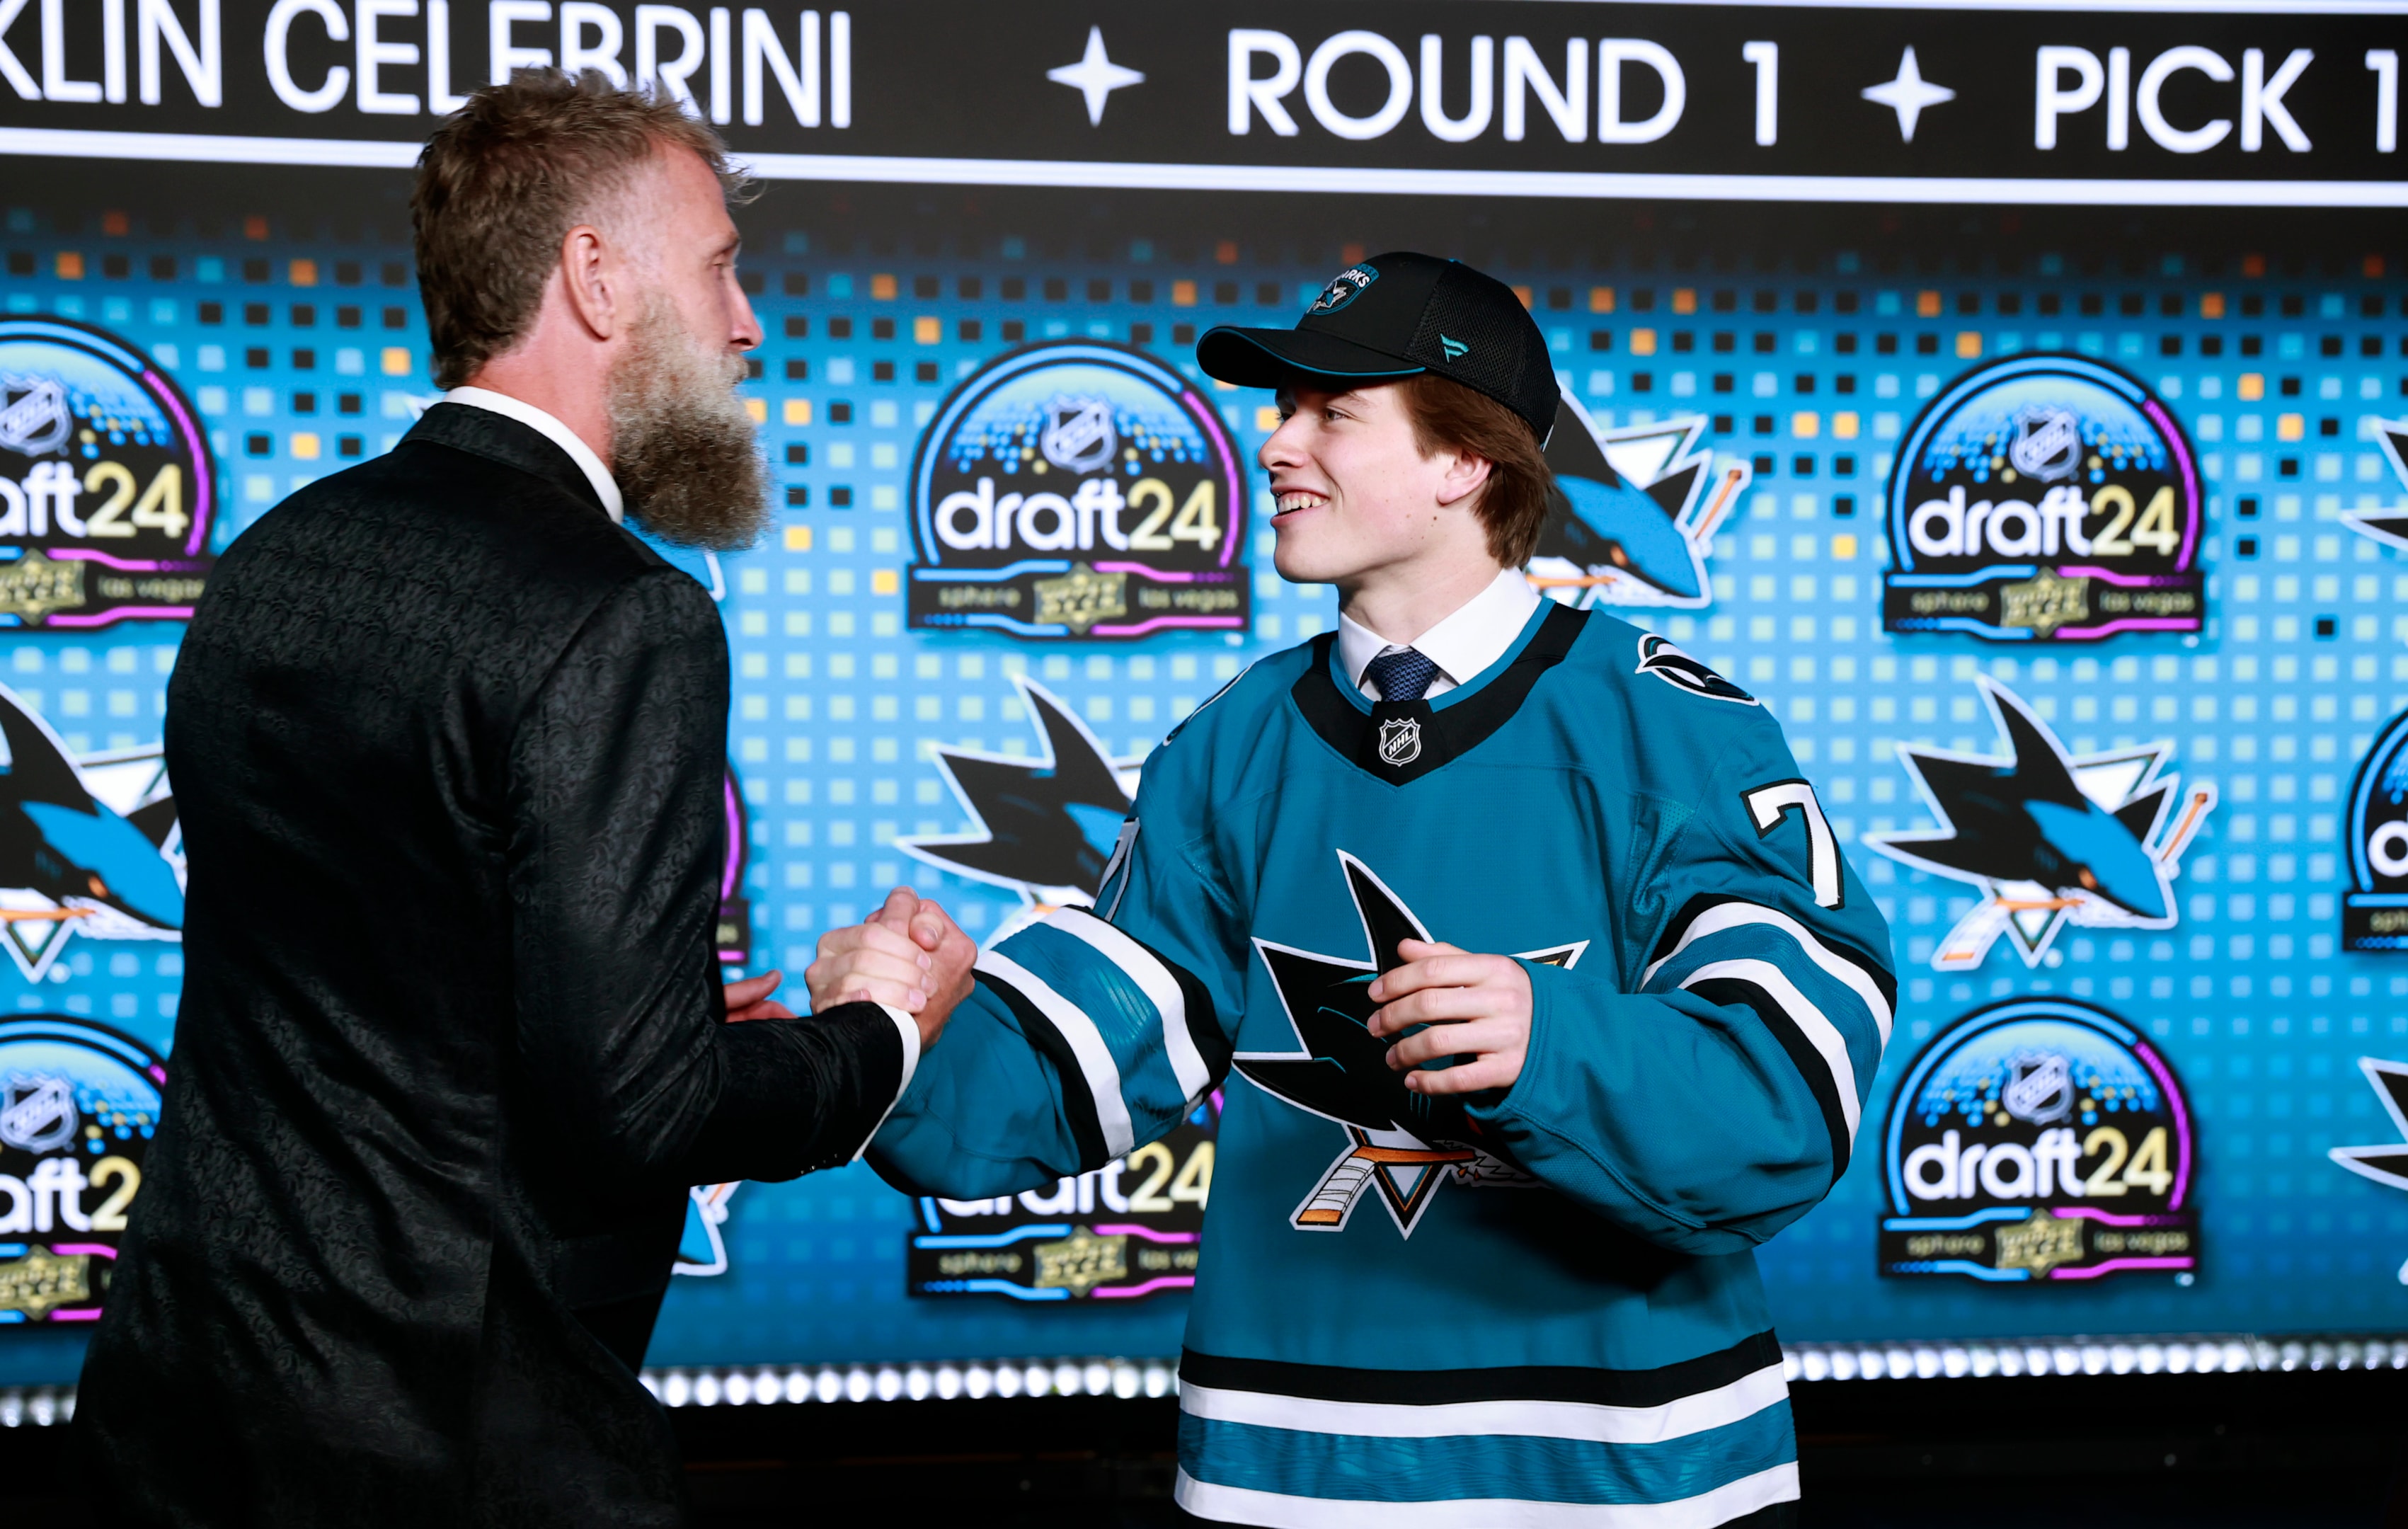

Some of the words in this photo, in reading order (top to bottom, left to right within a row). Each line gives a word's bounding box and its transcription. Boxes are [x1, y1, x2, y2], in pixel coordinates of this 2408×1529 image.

[263, 0, 851, 129] CELEBRINI
[1228, 28, 1687, 144] ROUND
[1742, 41, 1779, 146] 1
[2034, 45, 2315, 154] PICK
[2365, 49, 2398, 154] 1
[935, 477, 1222, 551] draft24
[1909, 485, 2180, 557] draft24
[1387, 731, 1412, 756] NHL
[1740, 778, 1845, 911] 7
[1904, 1126, 2173, 1200] draft24
